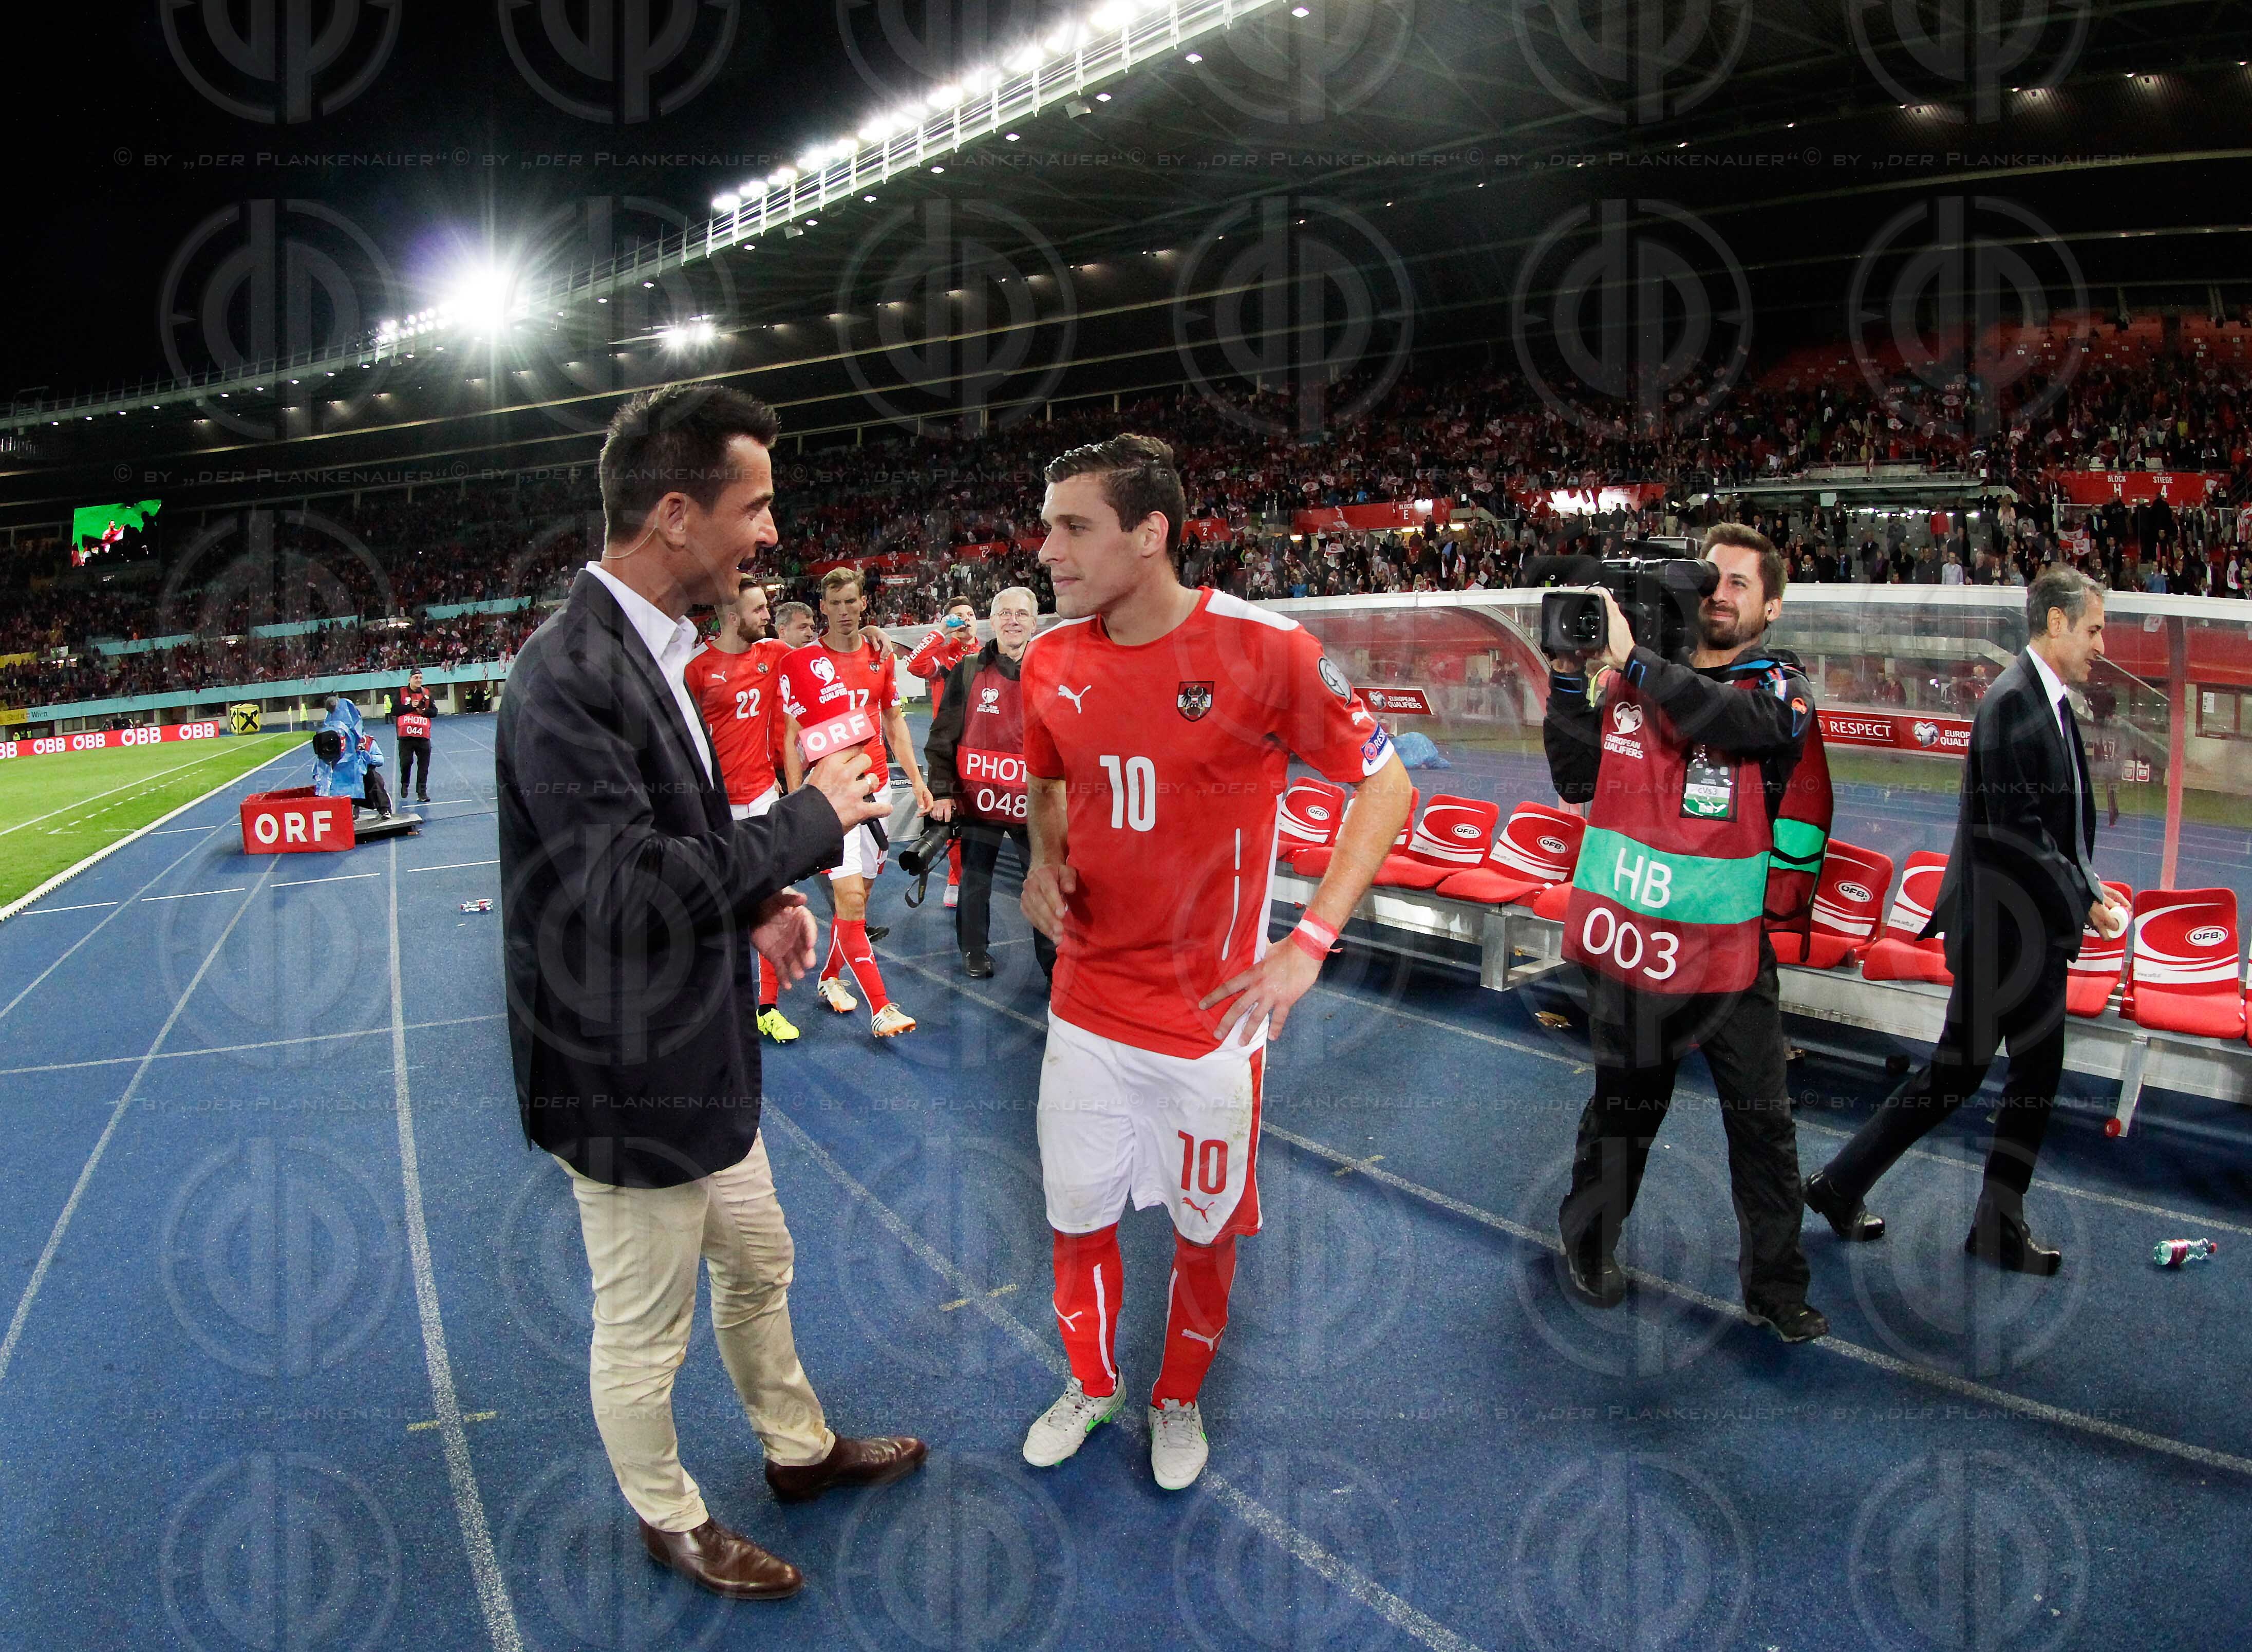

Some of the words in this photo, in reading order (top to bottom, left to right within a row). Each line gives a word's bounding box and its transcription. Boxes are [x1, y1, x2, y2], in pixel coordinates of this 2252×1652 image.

[2161, 484, 2168, 498] 4
[1403, 510, 1409, 520] E
[736, 688, 760, 719] 22
[848, 689, 869, 710] 17
[403, 716, 427, 725] PHOTO
[406, 725, 423, 736] 044
[807, 714, 866, 751] ORF
[1830, 721, 1891, 737] RESPECT
[0, 741, 17, 759] BB
[1605, 734, 1641, 749] EUROPEAN
[967, 753, 1027, 782] PHOT
[977, 789, 1027, 818] 048
[1099, 755, 1156, 832] 10
[255, 810, 332, 844] ORF
[1614, 848, 1672, 909] HB
[1583, 907, 1679, 980] 003
[1178, 1130, 1228, 1195] 10
